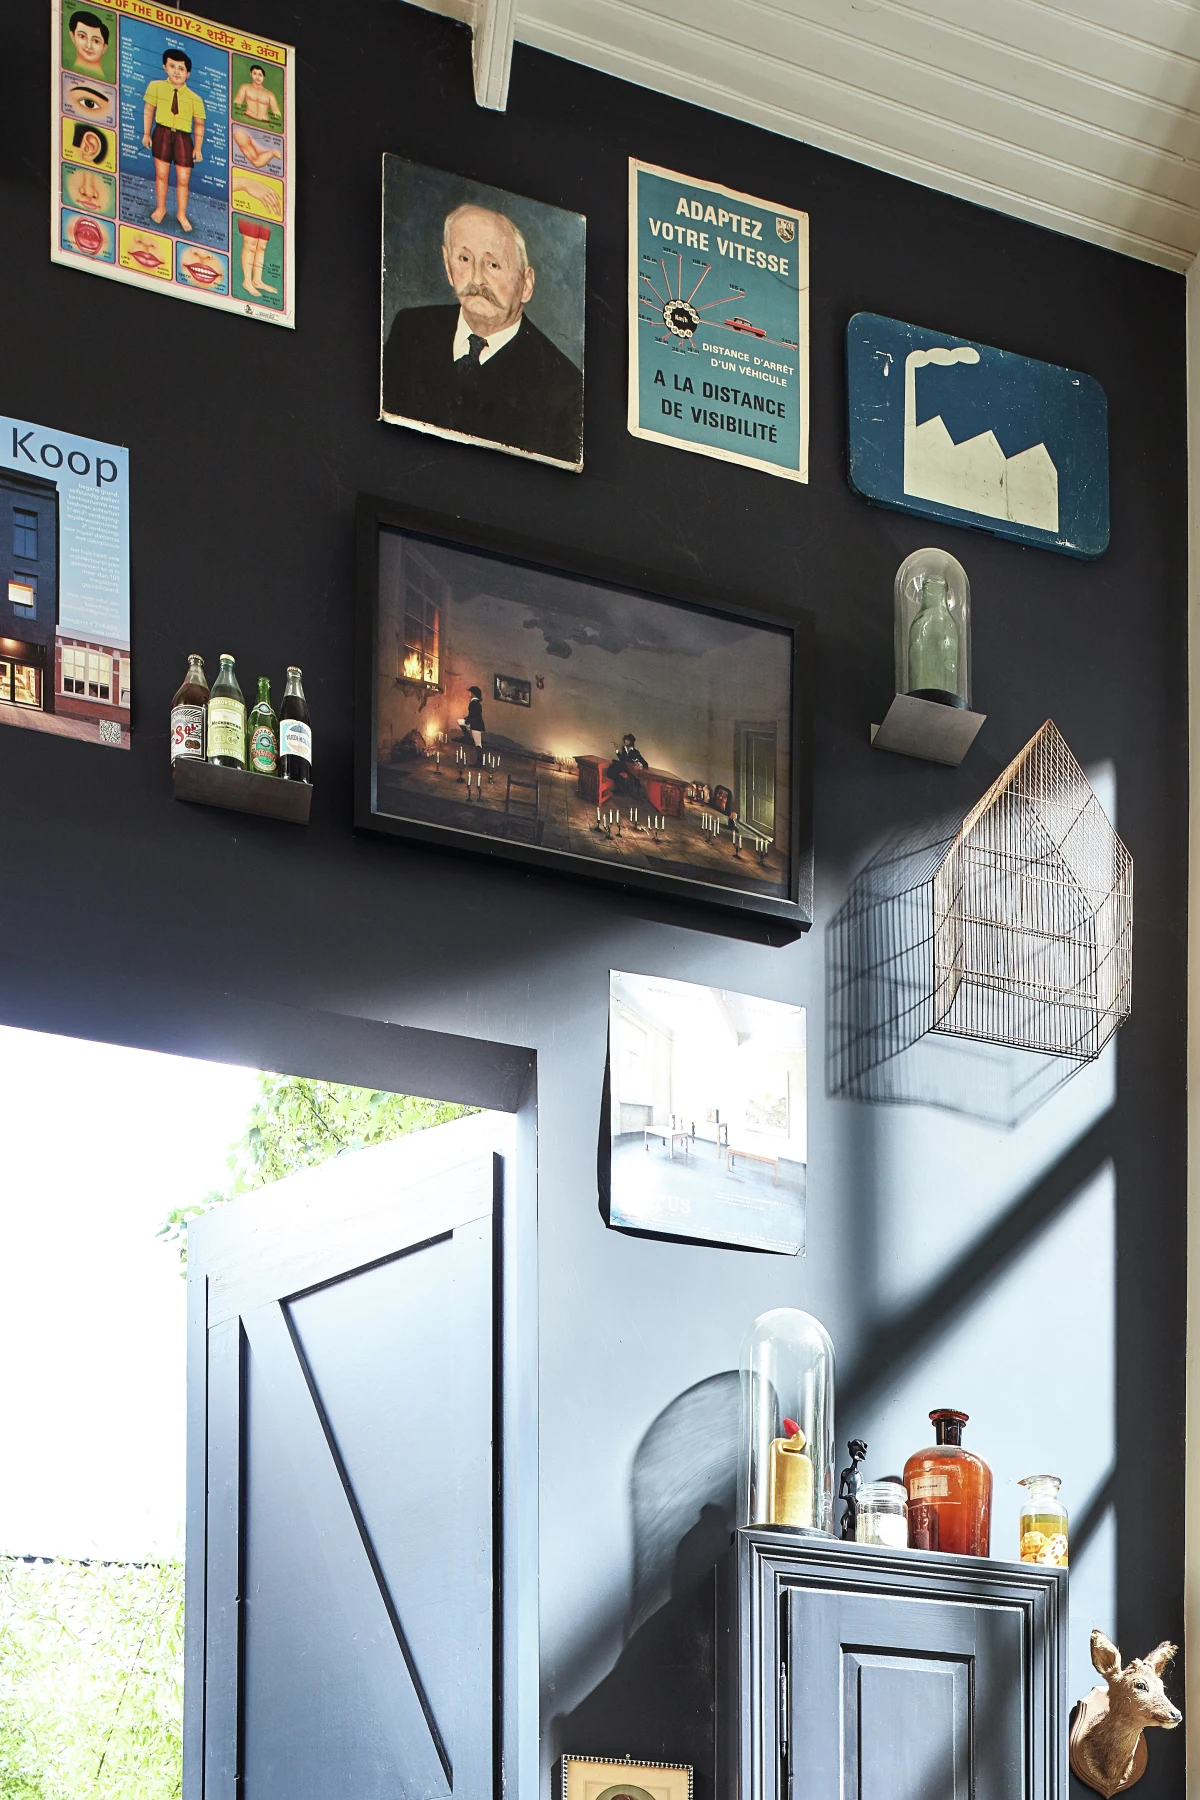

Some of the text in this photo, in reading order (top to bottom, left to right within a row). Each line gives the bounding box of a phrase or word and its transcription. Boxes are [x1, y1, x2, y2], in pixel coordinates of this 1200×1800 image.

[132, 2, 152, 17] THE
[156, 9, 202, 33] BODY-2
[206, 29, 279, 60] शरीर के अंग
[676, 197, 763, 241] ADAPTEZ
[648, 218, 789, 276] VOTRE VITESSE
[702, 342, 794, 376] DISTANCE D'ARRÊT
[710, 358, 788, 388] D'UN VÉHICULE
[654, 370, 786, 419] A LA DISTANCE
[661, 398, 778, 444] DE VISIBILITÉ
[12, 427, 118, 488] Koop
